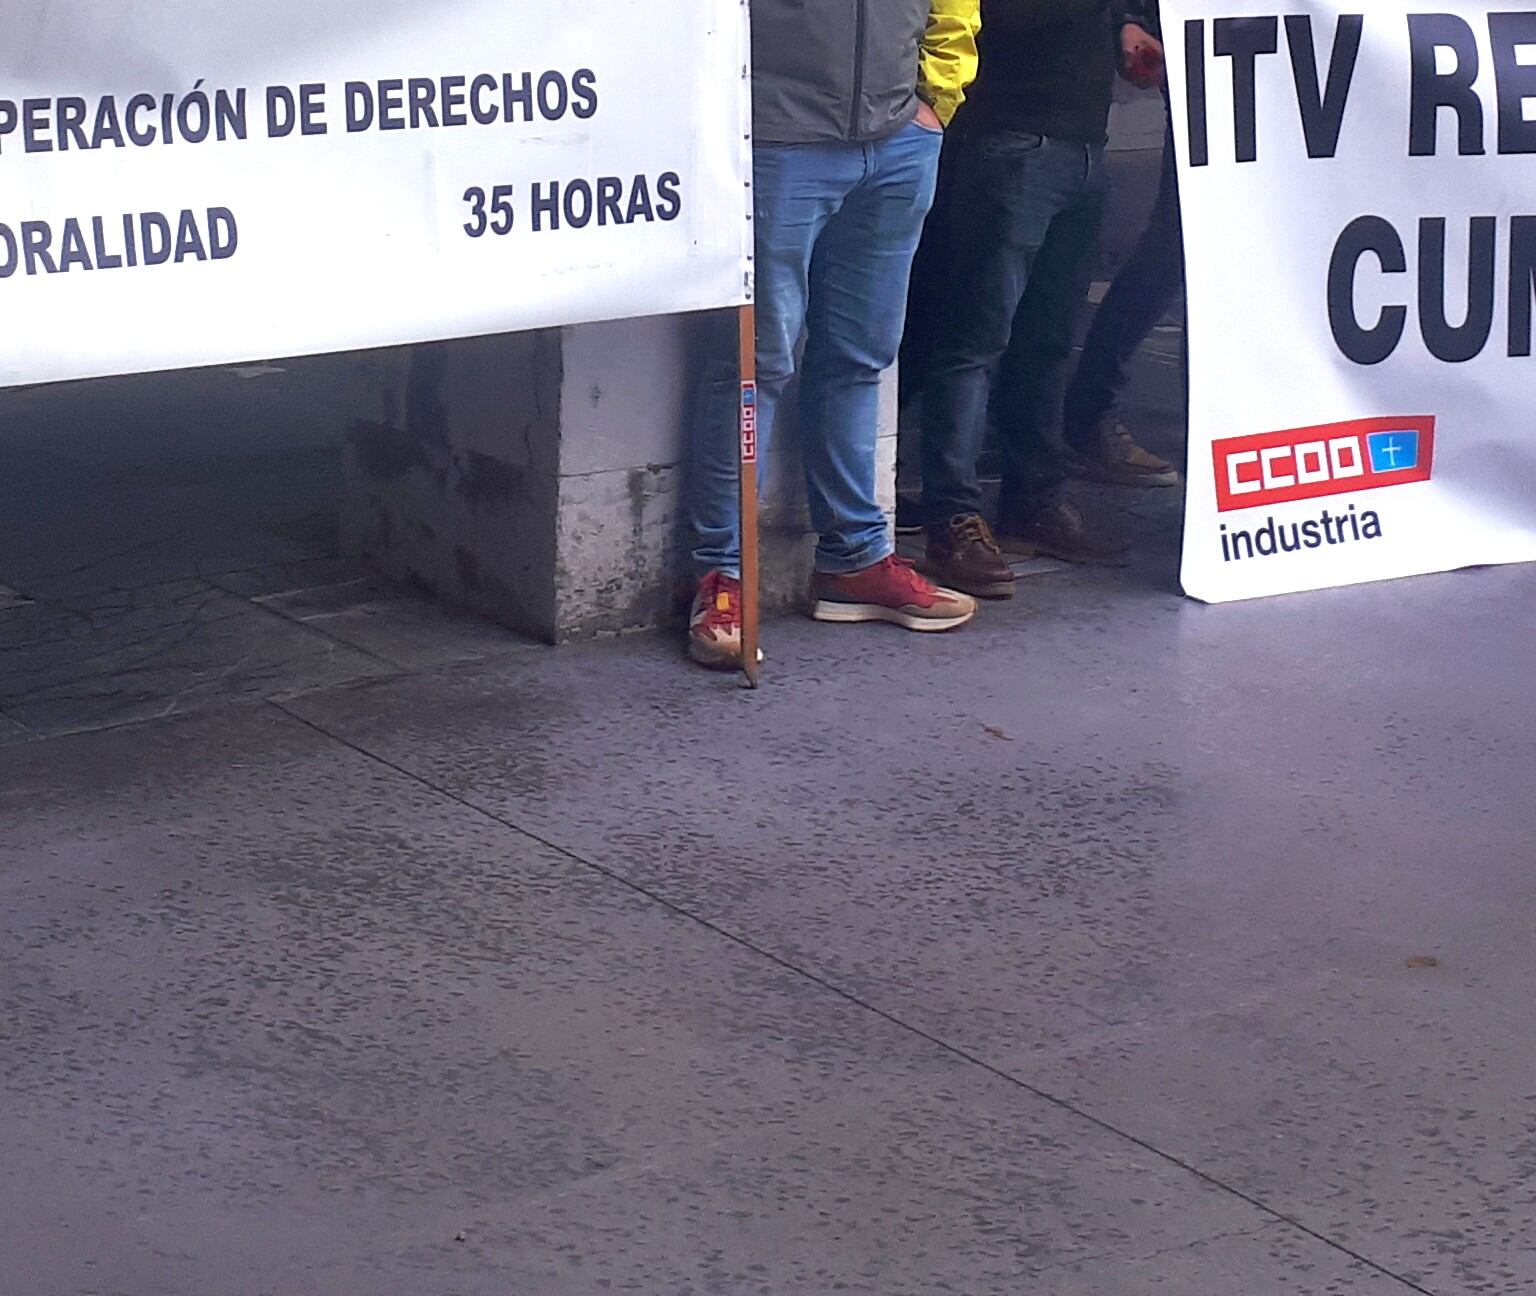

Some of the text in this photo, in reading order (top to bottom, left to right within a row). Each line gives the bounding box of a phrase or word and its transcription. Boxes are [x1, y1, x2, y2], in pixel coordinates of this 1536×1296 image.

[265, 83, 329, 139] DE
[344, 68, 599, 134] DERECHOS
[1183, 13, 1365, 167] ITV
[462, 171, 682, 238] 35 HORAS
[1225, 439, 1365, 497] CCOO
[1218, 504, 1384, 564] industria
